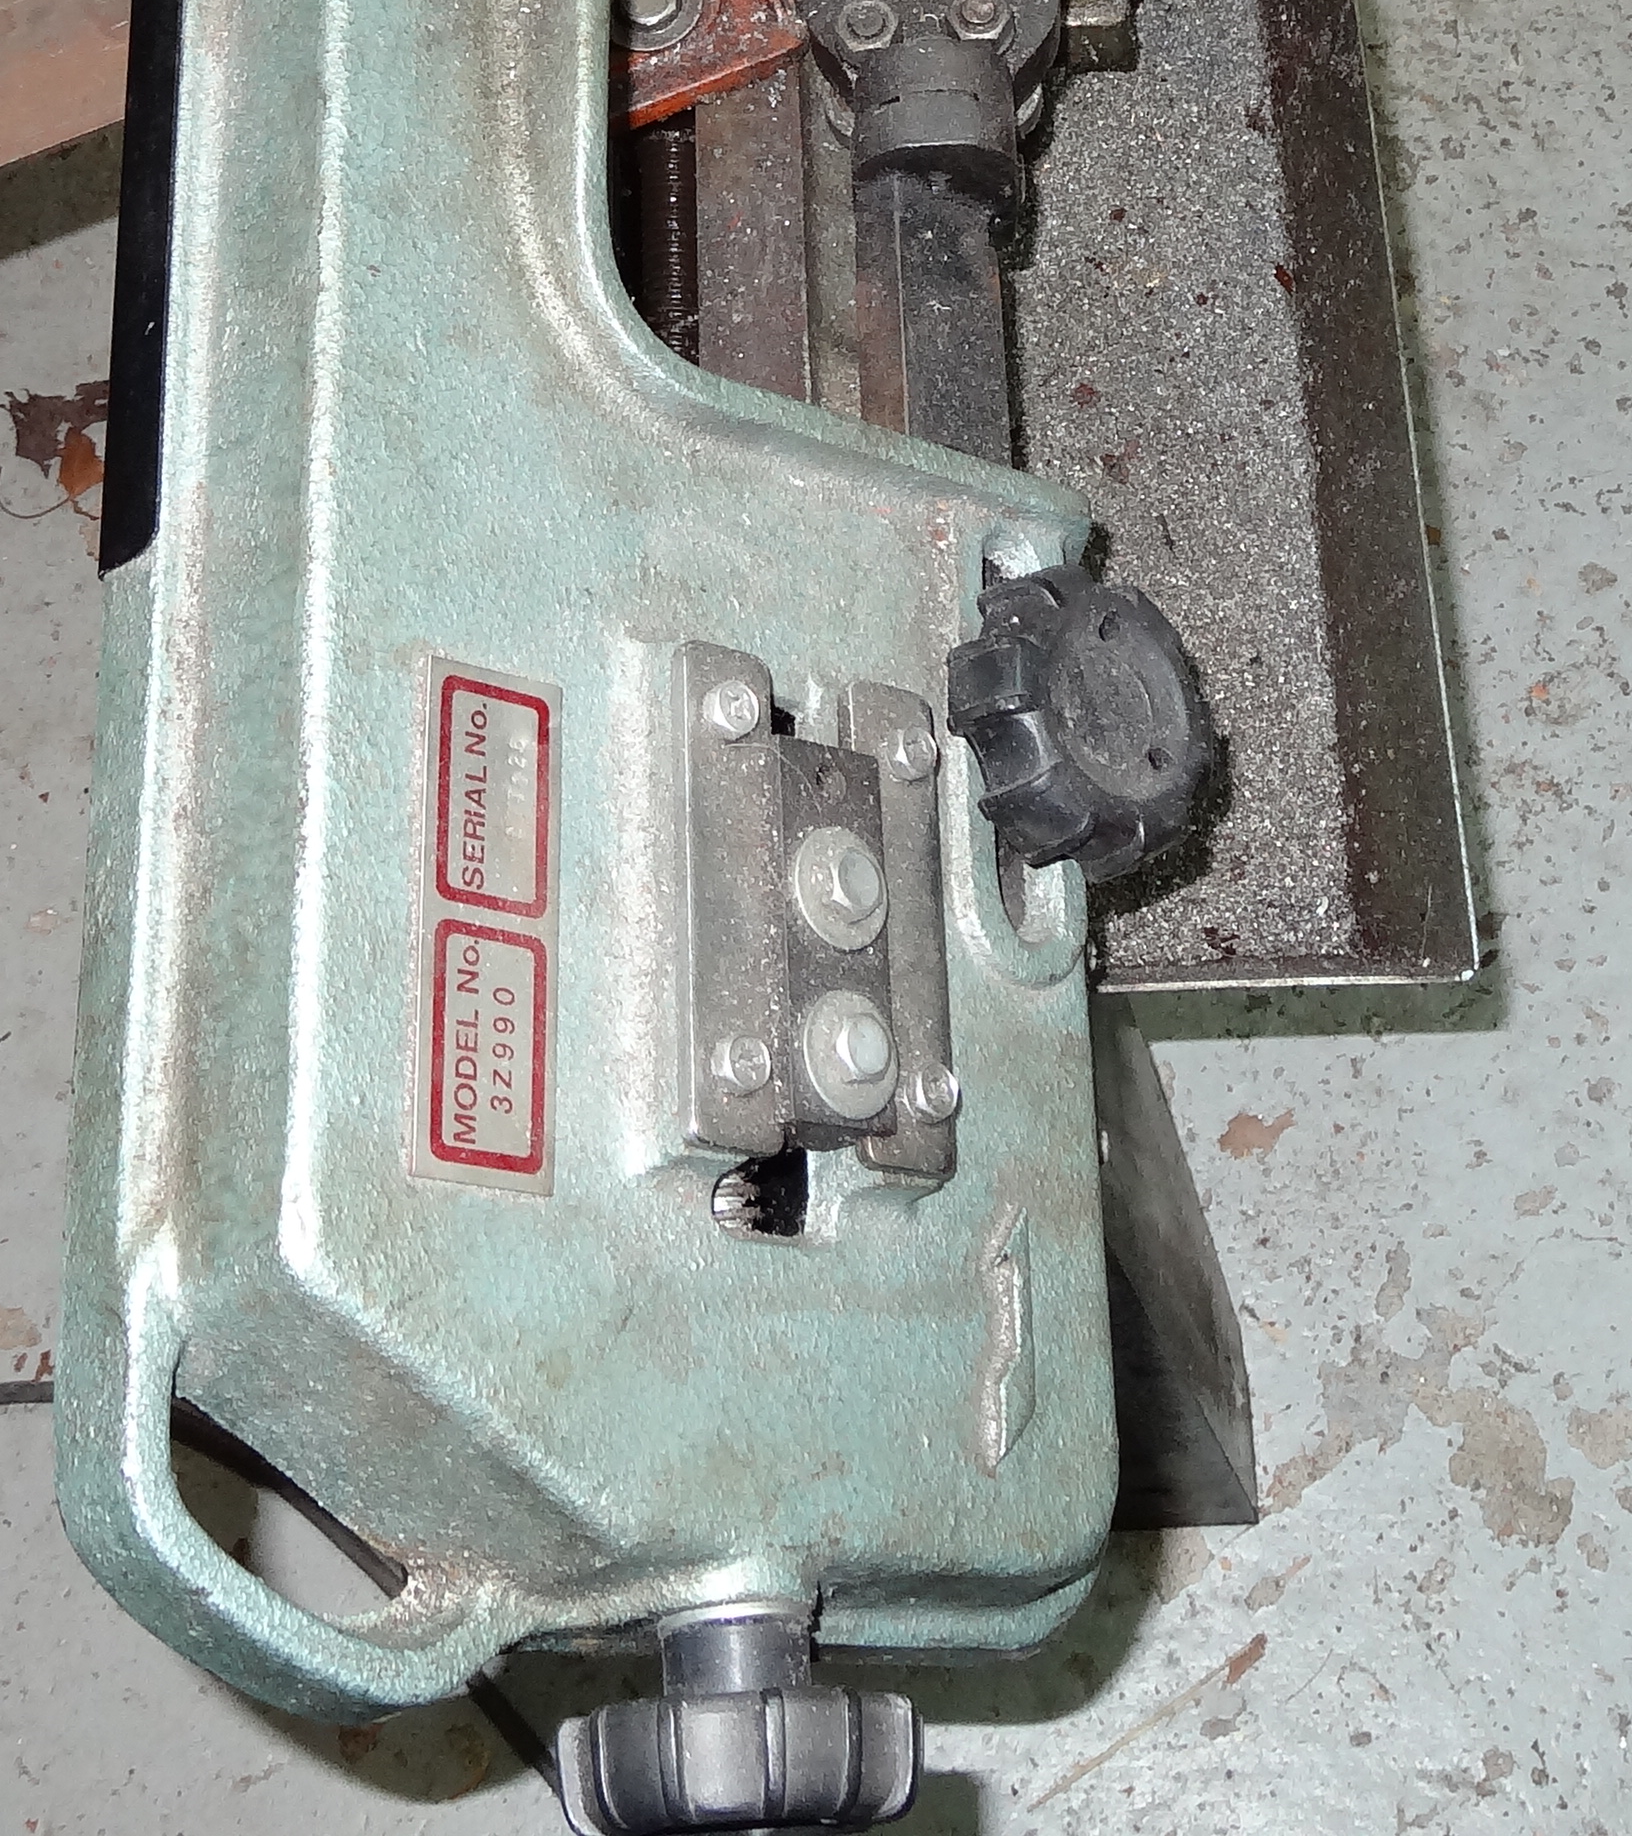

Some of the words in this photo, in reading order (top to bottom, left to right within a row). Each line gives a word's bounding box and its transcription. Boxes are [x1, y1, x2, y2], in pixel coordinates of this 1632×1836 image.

[464, 702, 488, 757] No.
[461, 765, 487, 890] SERIAL
[456, 939, 480, 995] No.
[453, 1009, 479, 1145] MODEL
[490, 986, 516, 1114] 3Z990
